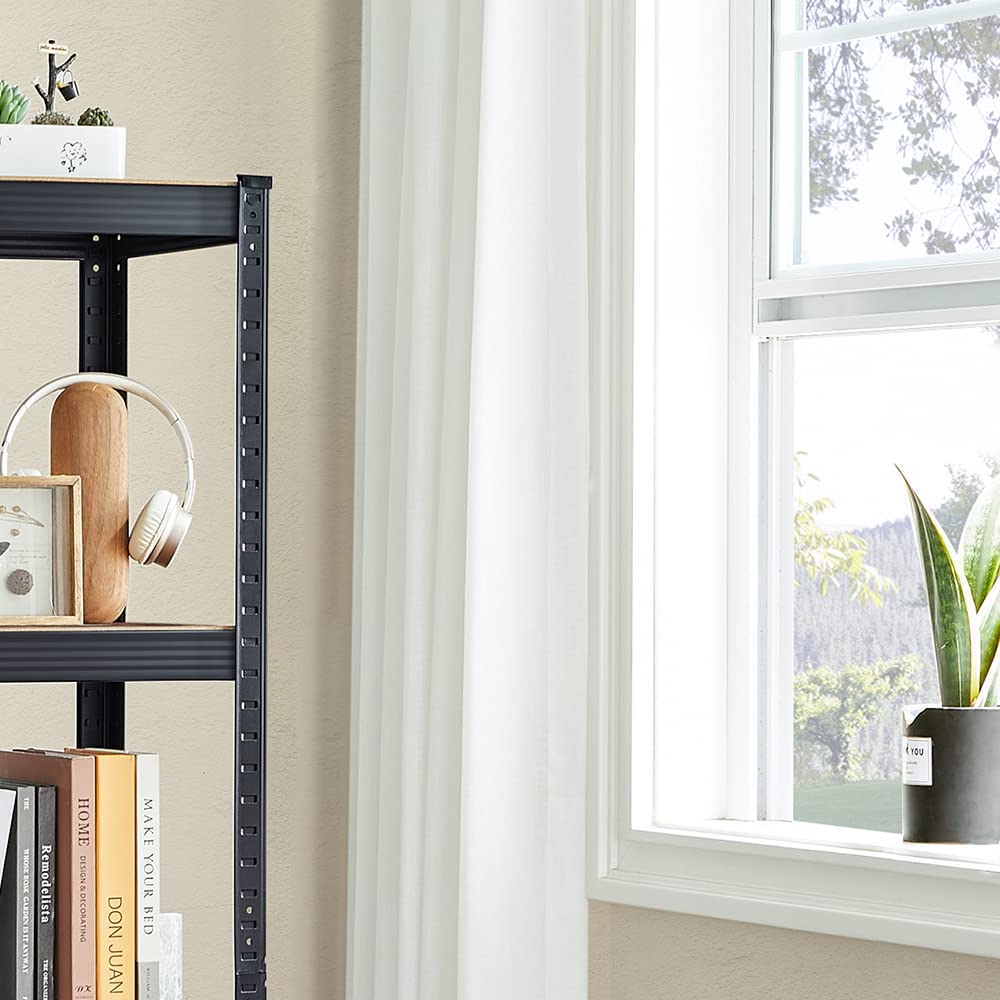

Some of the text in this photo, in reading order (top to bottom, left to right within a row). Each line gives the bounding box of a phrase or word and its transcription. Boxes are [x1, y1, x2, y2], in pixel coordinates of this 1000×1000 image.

[910, 747, 924, 756] YOU
[78, 797, 90, 847] HOME
[41, 844, 52, 924] Remodelista
[79, 855, 87, 884] DESIGN
[143, 798, 154, 935] MAKE YOUR BED
[79, 893, 87, 943] DECORATING
[107, 896, 124, 994] DON JUAN
